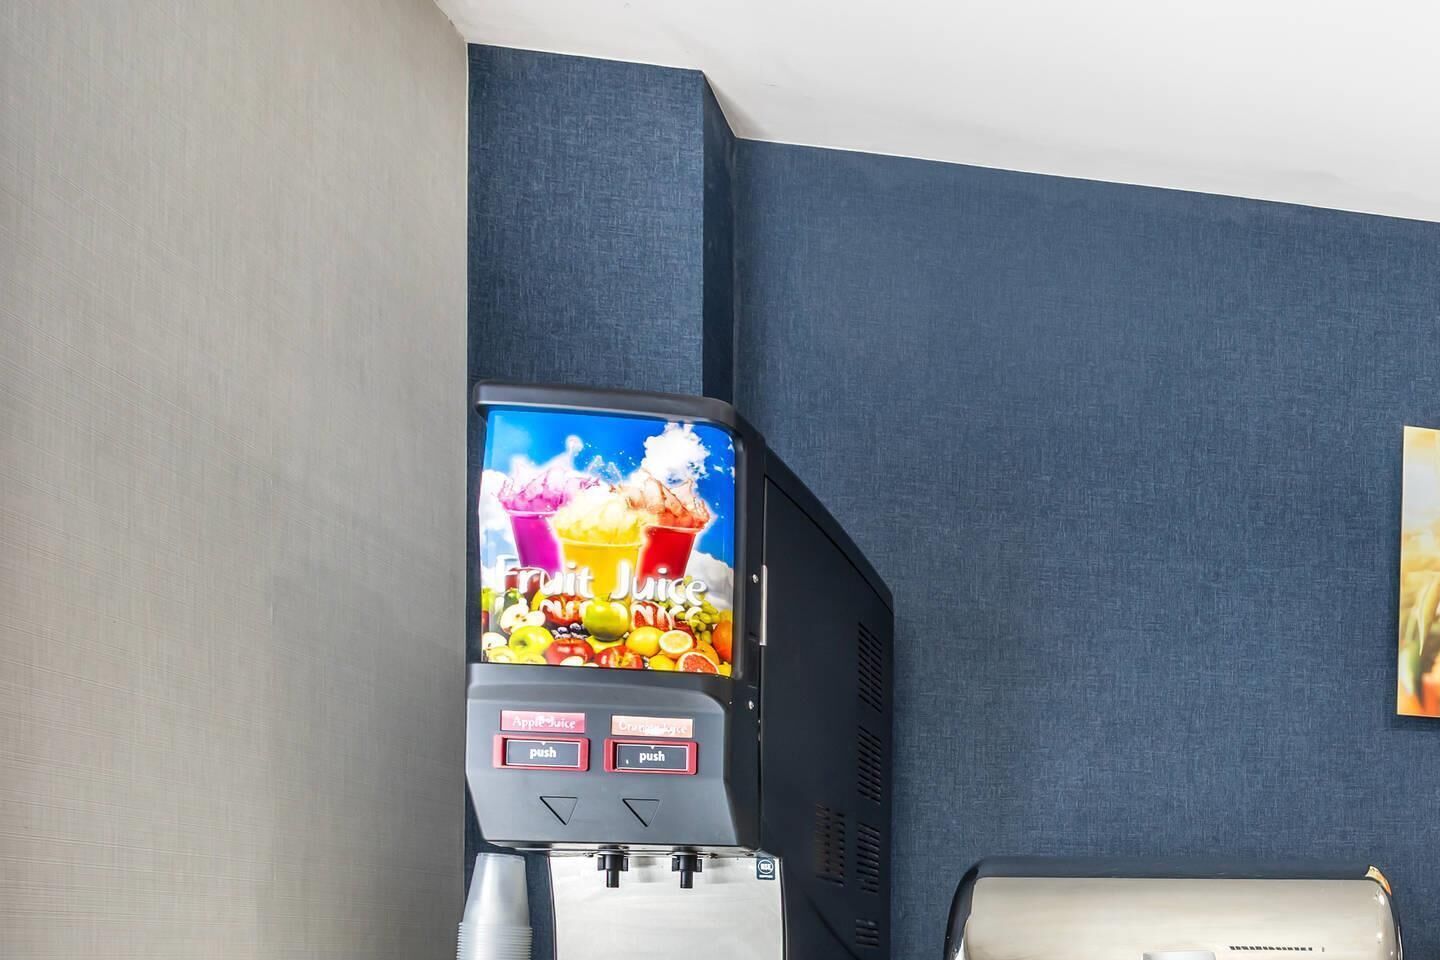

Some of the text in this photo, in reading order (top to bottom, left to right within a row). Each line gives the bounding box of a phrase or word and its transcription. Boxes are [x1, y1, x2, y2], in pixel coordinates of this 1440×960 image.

[497, 560, 708, 606] Fruit Juice
[512, 715, 576, 730] Apple Juice
[529, 746, 557, 760] push
[639, 750, 666, 763] push
